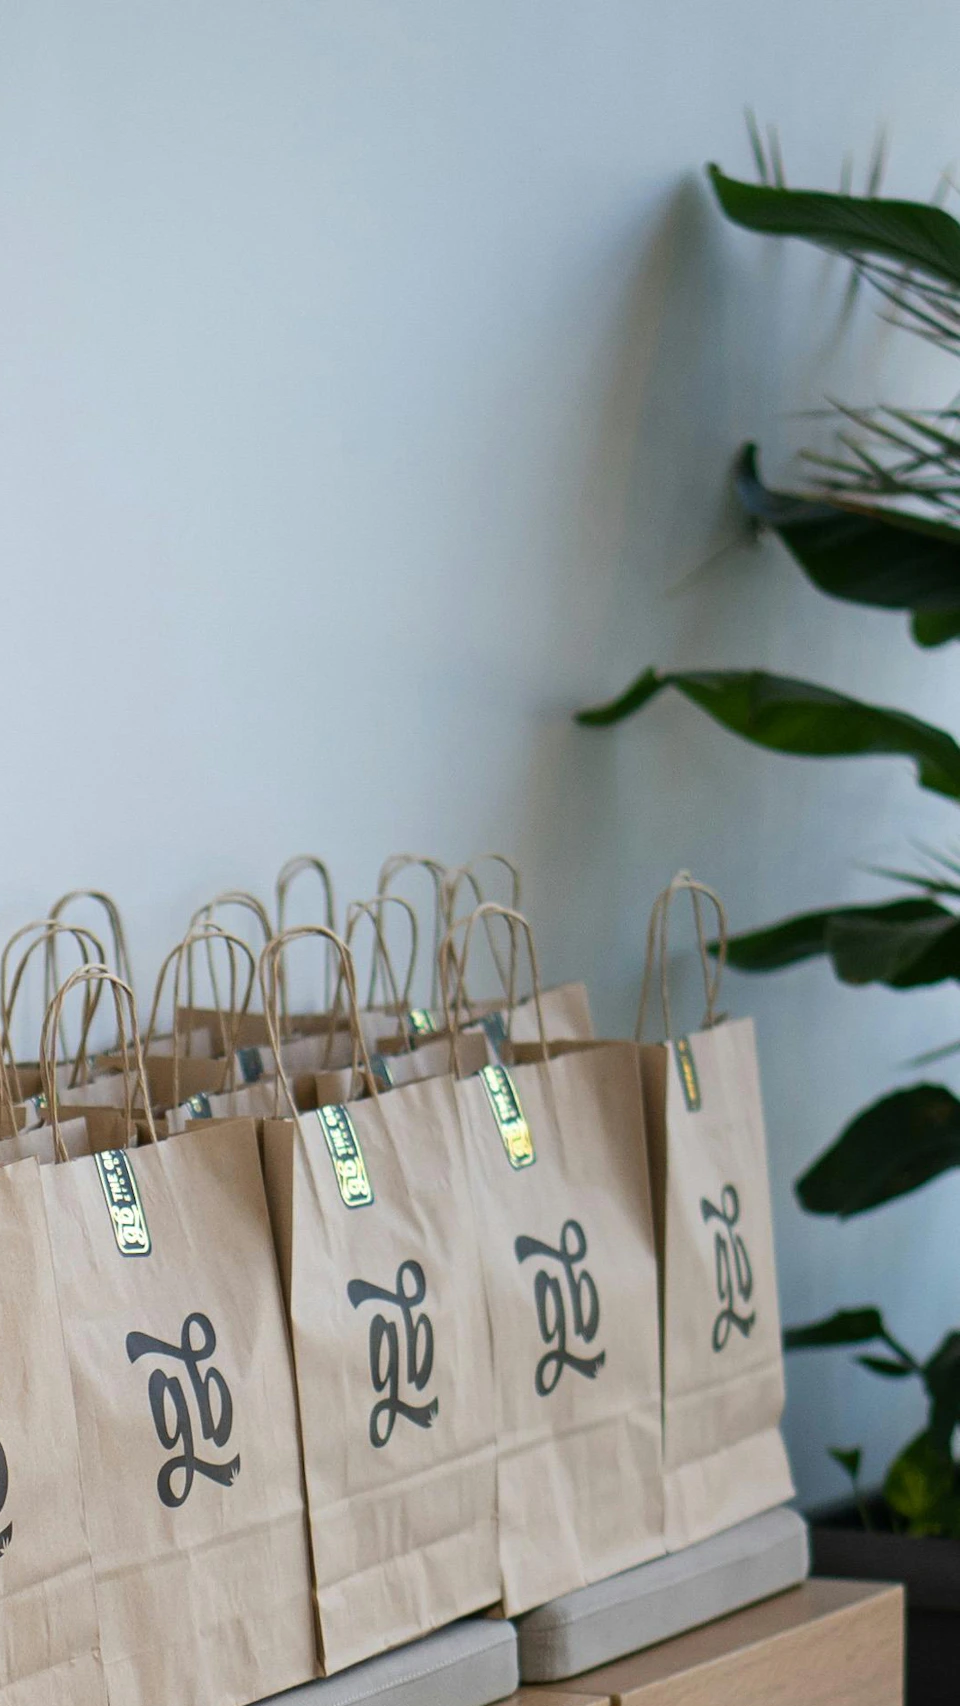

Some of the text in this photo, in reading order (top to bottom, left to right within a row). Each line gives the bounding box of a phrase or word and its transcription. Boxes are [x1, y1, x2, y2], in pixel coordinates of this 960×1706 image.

[106, 1173, 124, 1202] THE
[347, 1260, 439, 1448] gb
[515, 1219, 606, 1397] gb
[126, 1311, 241, 1508] gb
